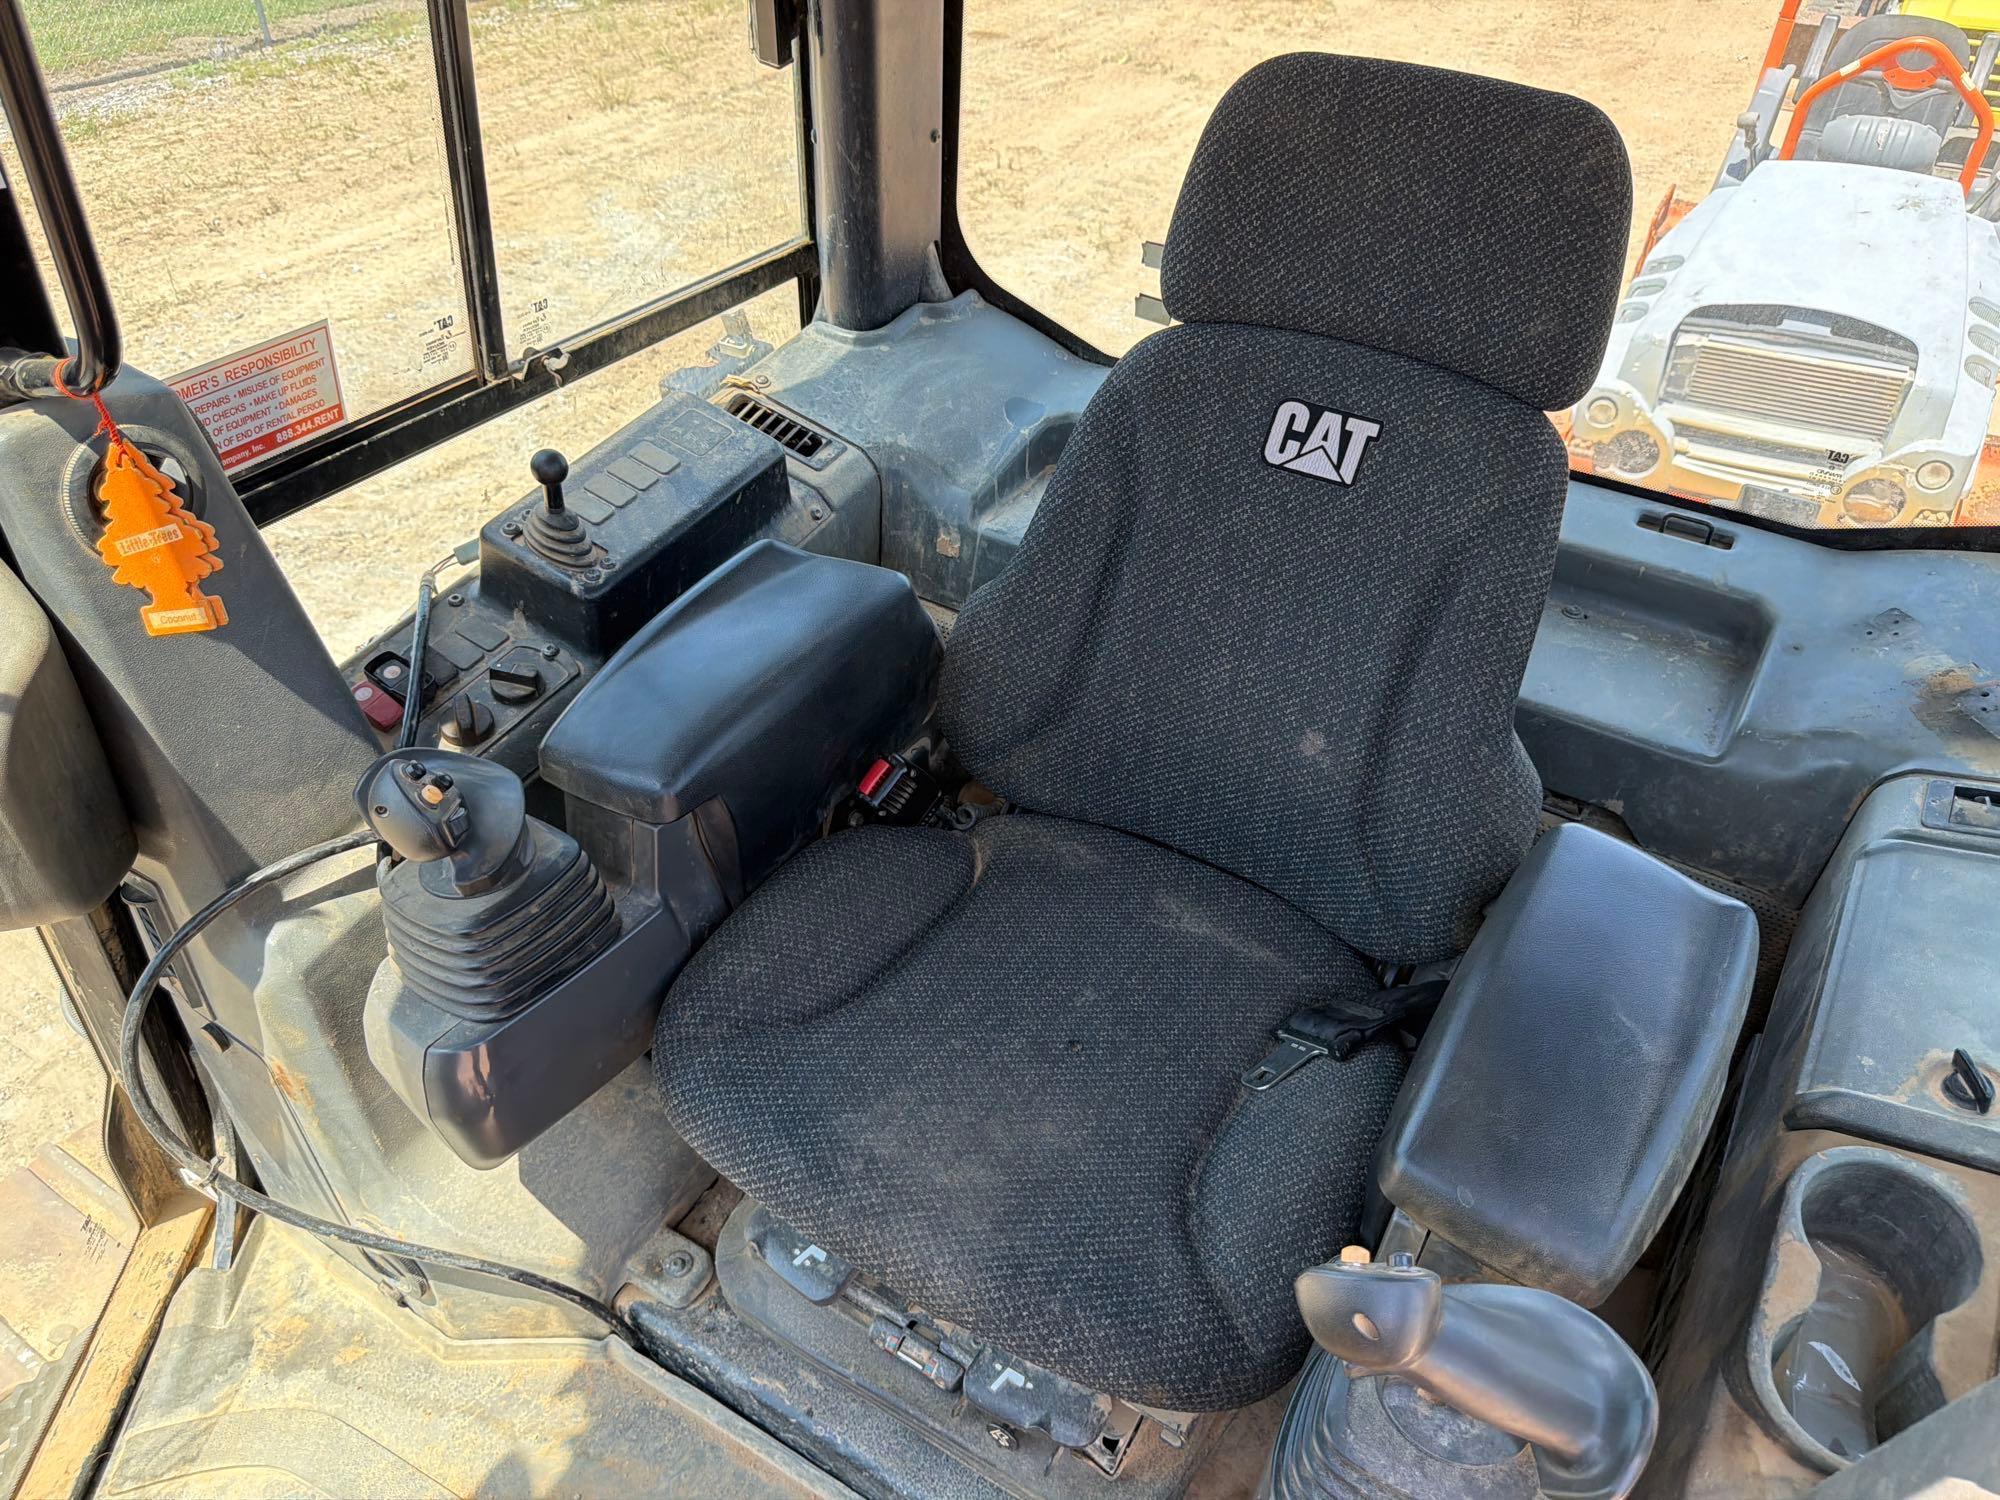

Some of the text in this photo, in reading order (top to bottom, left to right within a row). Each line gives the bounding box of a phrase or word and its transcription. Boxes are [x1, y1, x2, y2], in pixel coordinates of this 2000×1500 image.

[224, 338, 316, 382] RESPONSIBILITY
[194, 357, 326, 415] REPAIRS MISUSE OF EQUIPMENT
[213, 403, 247, 422] CHECKS
[253, 391, 278, 406] MAKE
[278, 385, 289, 397] UP
[290, 375, 317, 392] FLUIDS
[213, 388, 318, 438] OF EQUIPMENT DAMAGES
[223, 436, 235, 447] OF
[236, 428, 253, 442] END
[254, 423, 265, 434] OF
[266, 411, 297, 430] RENTAL
[297, 399, 325, 416] PERIOD
[252, 443, 266, 454] Inc.
[276, 408, 339, 443] 888.344.RENT
[1264, 401, 1381, 485] CAT
